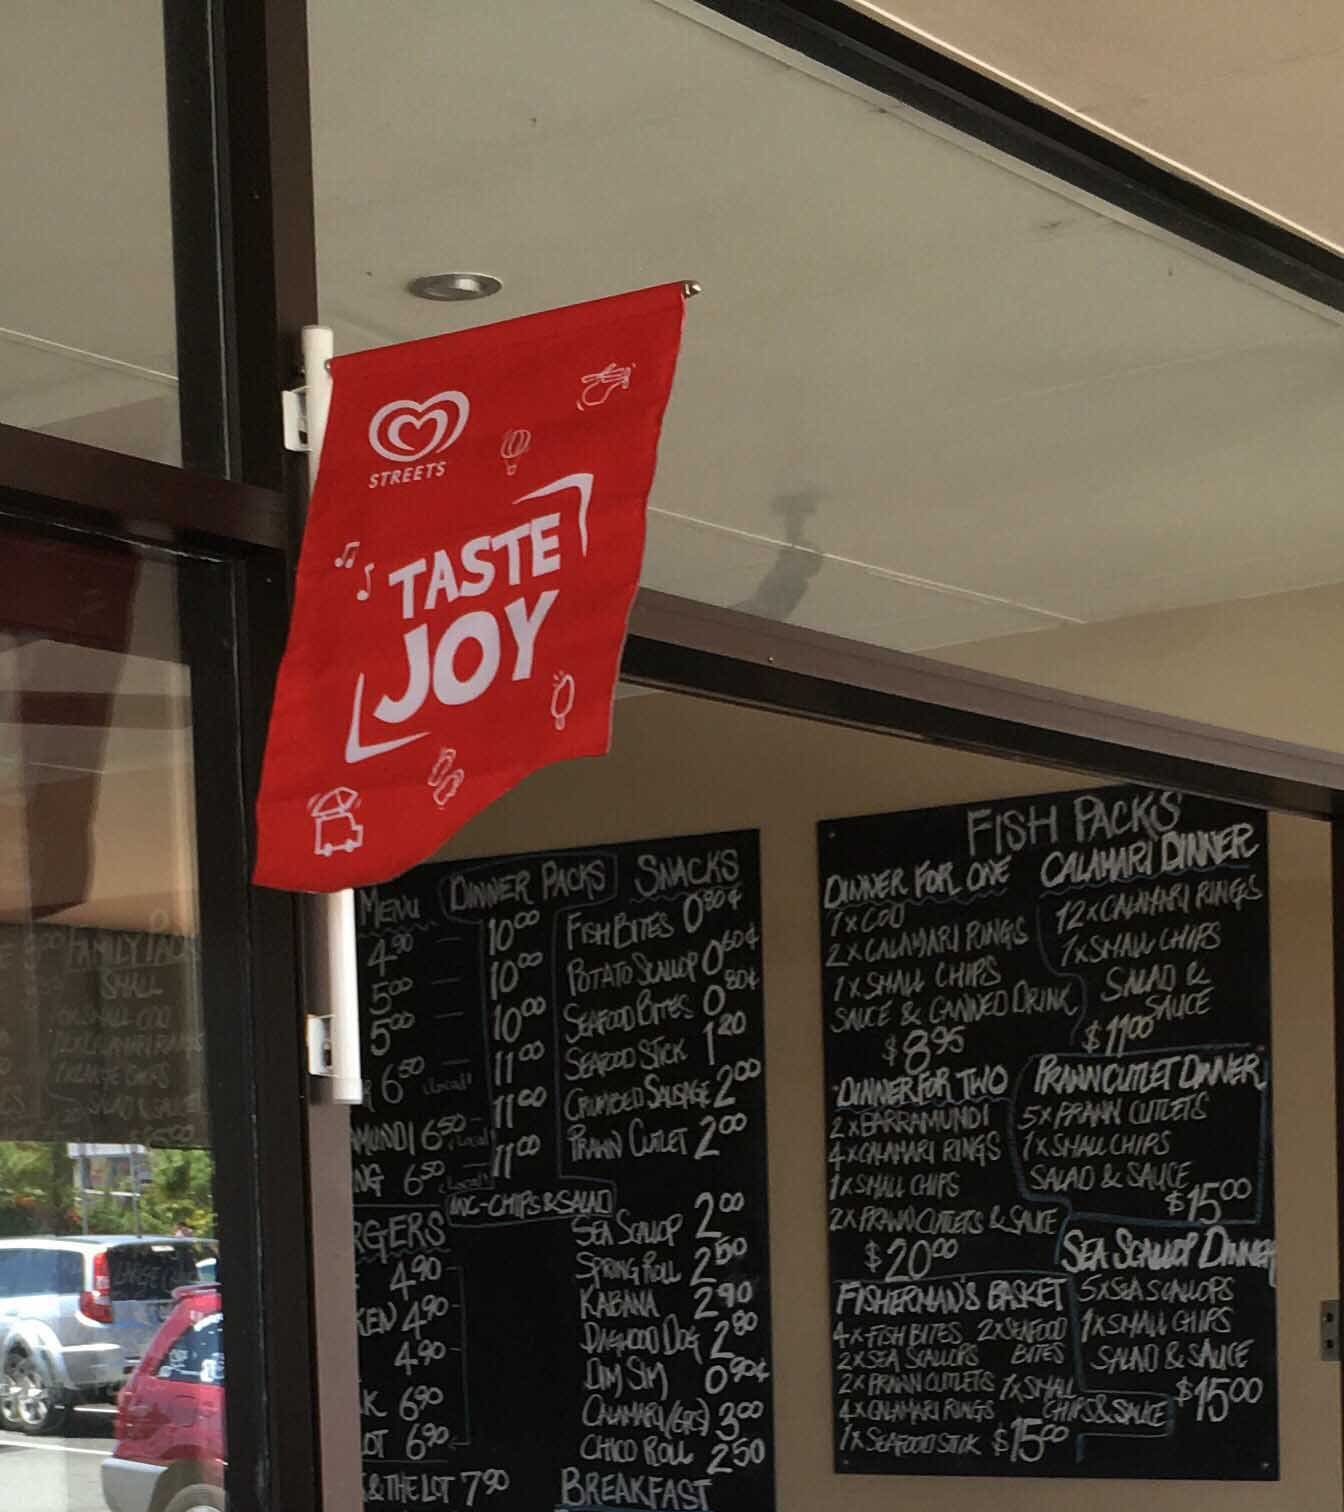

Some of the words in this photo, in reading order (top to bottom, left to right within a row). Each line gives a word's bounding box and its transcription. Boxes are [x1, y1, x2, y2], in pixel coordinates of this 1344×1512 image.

[368, 461, 447, 490] STREETS
[388, 512, 562, 619] TASTE
[372, 589, 561, 725] JOY
[967, 804, 1057, 856] FISH
[1074, 791, 1182, 843] PACKS
[1161, 822, 1261, 872] DINNER
[448, 869, 535, 912] DINNER
[541, 858, 609, 901] PACKS
[633, 849, 739, 897] SNACKS
[824, 867, 909, 909] DINNER
[914, 860, 962, 898] FOR
[966, 855, 1012, 892] ONE
[614, 911, 675, 950] BITES
[1159, 921, 1222, 952] CHIPS
[566, 956, 634, 997] POTATO
[935, 954, 1002, 988] CHIPS
[830, 1000, 893, 1033] SAUCE
[1012, 980, 1077, 1017] DRINK
[836, 1076, 918, 1107] DINNER
[918, 1066, 953, 1103] FOR
[955, 1063, 1009, 1100] TWO
[1179, 1053, 1268, 1091] DINNER
[1109, 1129, 1174, 1156] CHIPS
[910, 1171, 960, 1199] CHIPS
[1028, 1163, 1096, 1192] SALAD
[1126, 1160, 1194, 1192] SAUCE
[1061, 1229, 1110, 1273] SEA
[578, 1284, 661, 1320] KABANA
[987, 1277, 1070, 1312] BASKET
[909, 1321, 964, 1347] BITES
[1171, 1306, 1235, 1334] CHIPS
[1009, 1343, 1067, 1365] BITES
[1187, 1337, 1256, 1371] SAUCE
[560, 1465, 713, 1512] BREAKFAST
